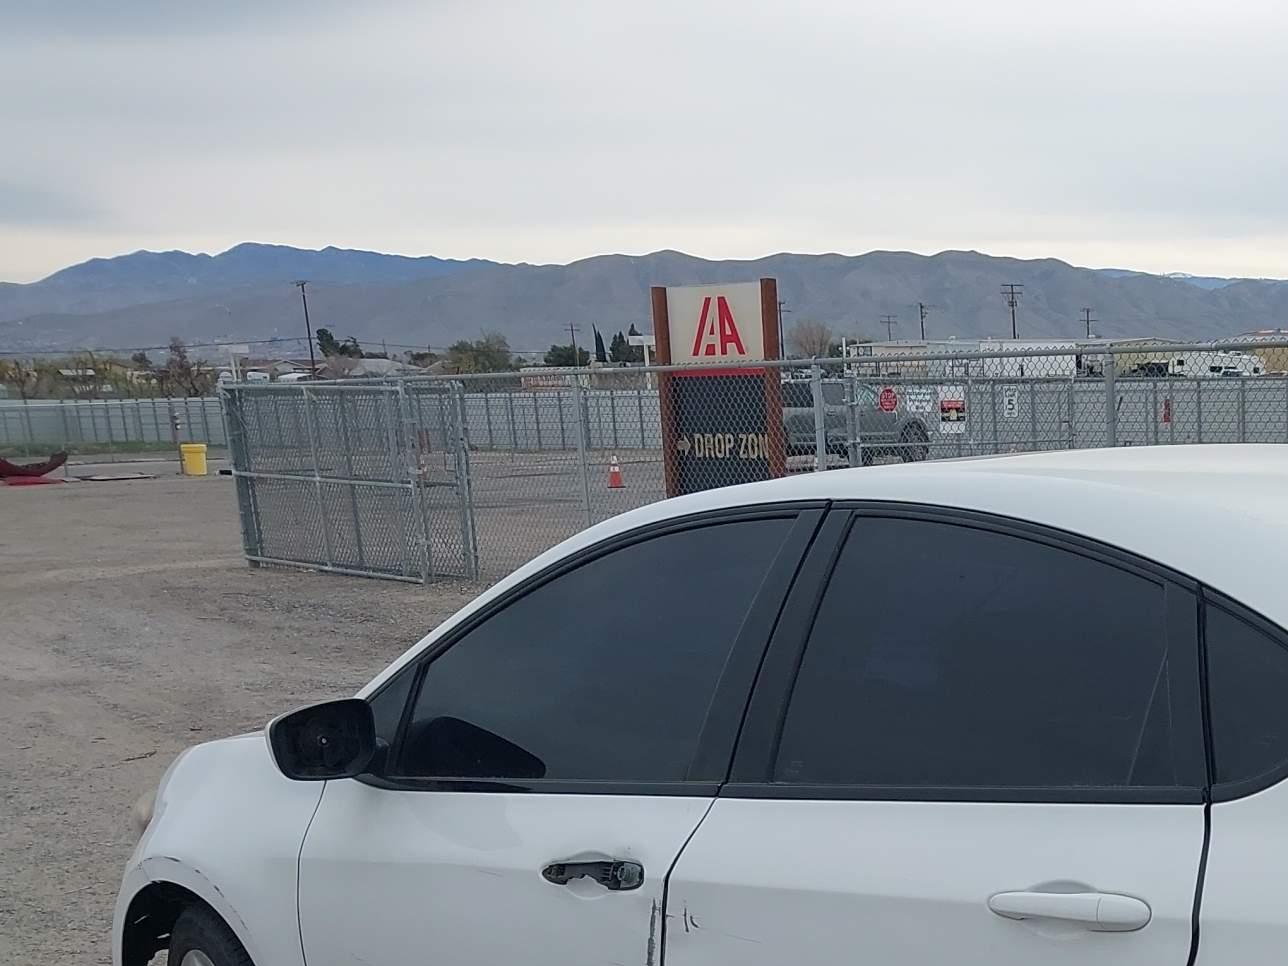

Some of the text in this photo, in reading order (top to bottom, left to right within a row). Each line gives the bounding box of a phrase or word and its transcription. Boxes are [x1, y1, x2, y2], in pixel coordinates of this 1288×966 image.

[1006, 398, 1015, 411] 5
[694, 433, 769, 459] DROP ZON
